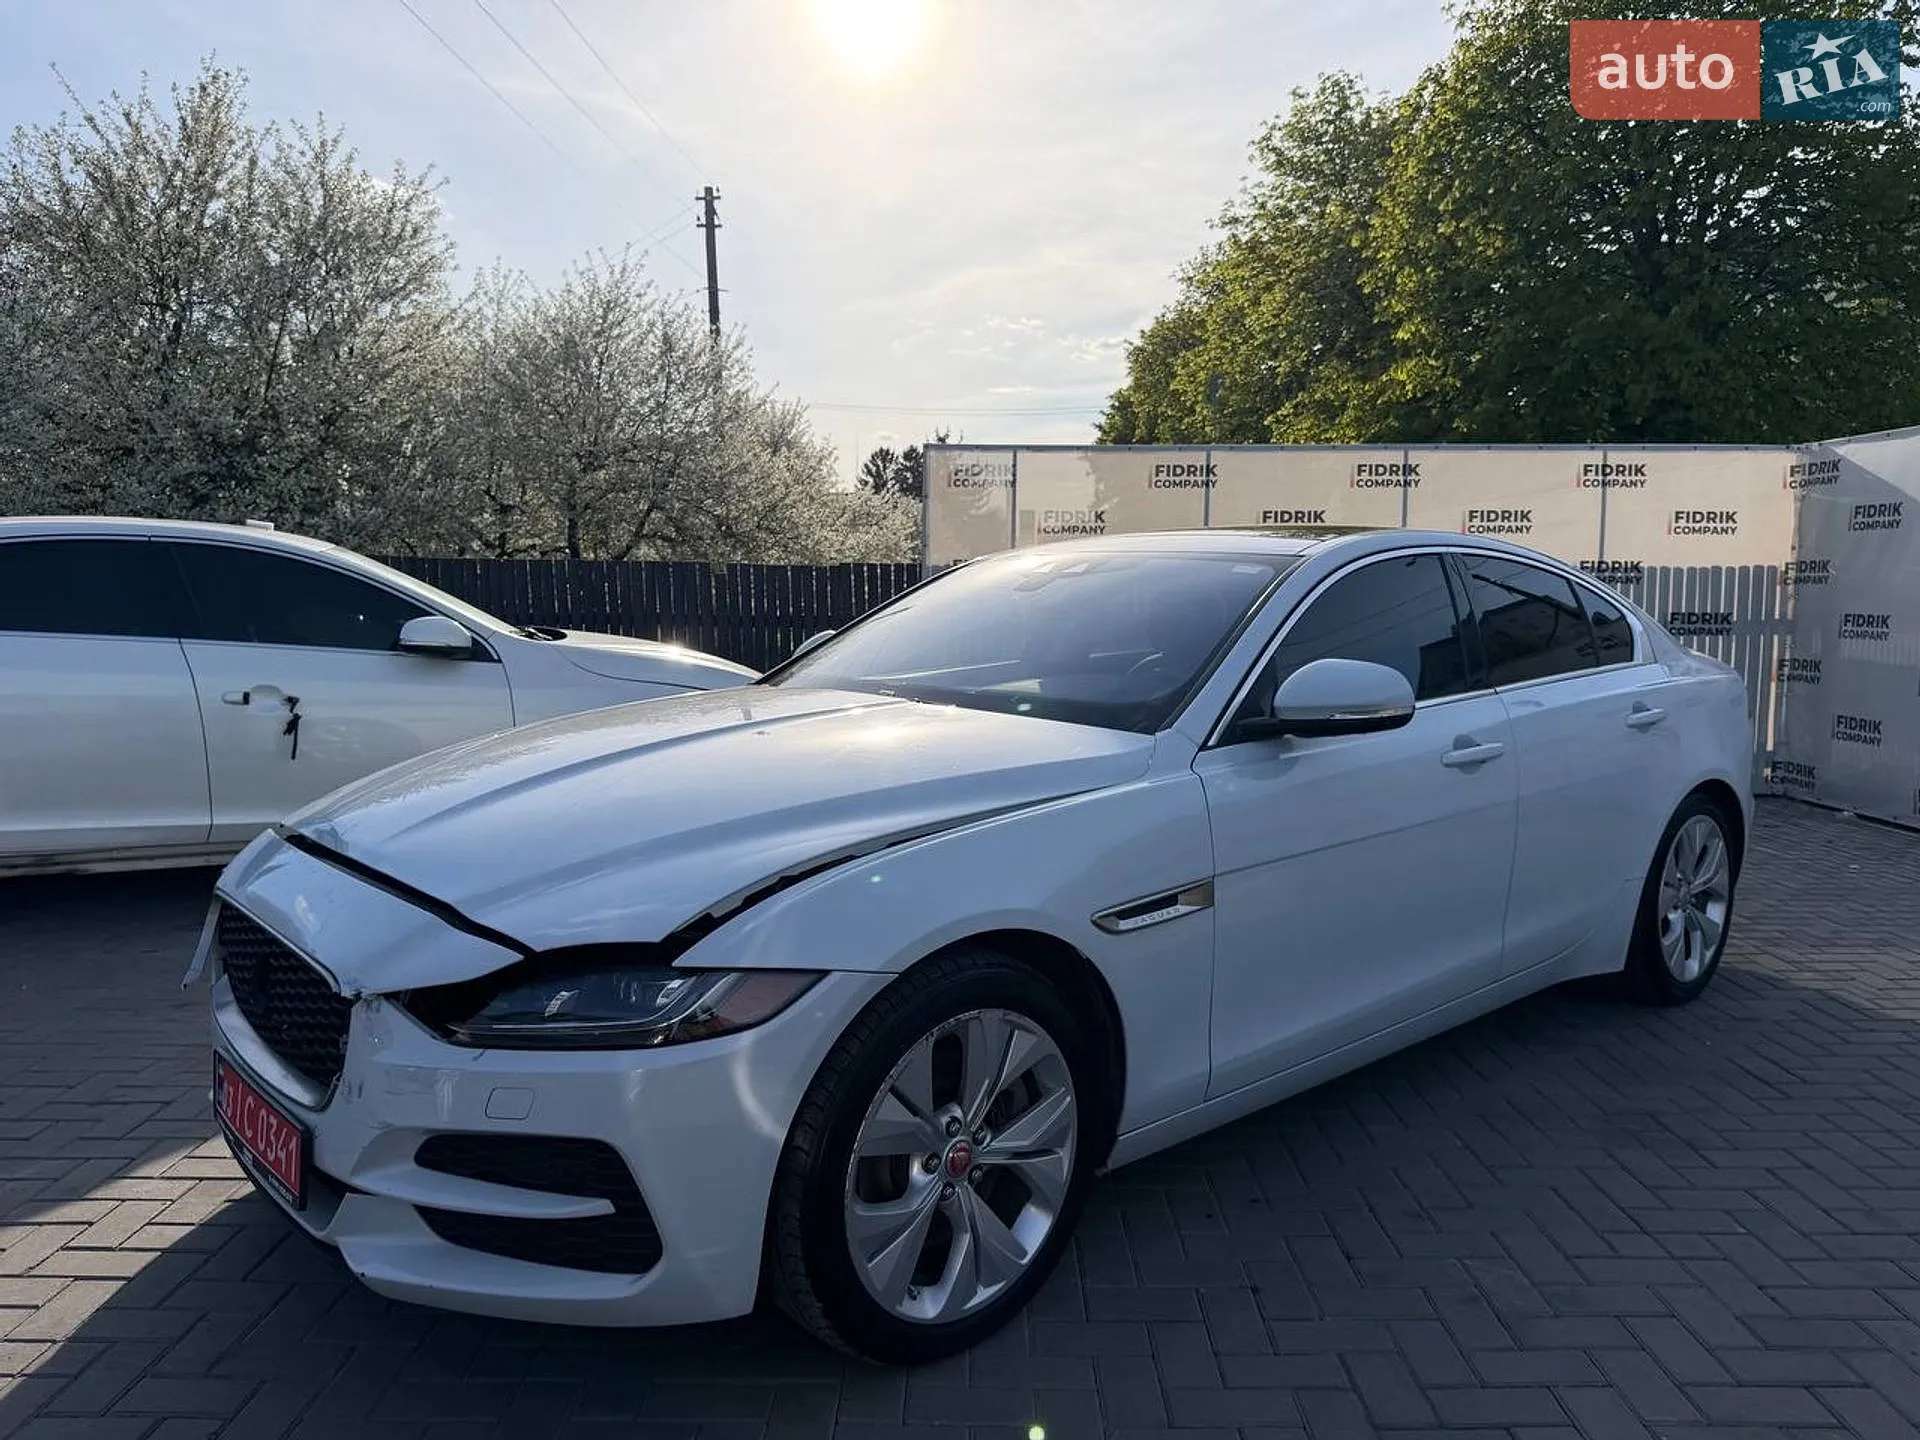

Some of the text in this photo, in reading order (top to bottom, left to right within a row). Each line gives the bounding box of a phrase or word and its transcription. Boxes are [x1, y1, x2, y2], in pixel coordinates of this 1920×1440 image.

[1154, 464, 1218, 477] FIDRIK
[1357, 464, 1421, 477] FIDRIK
[1583, 464, 1647, 477] FIDRIK
[1789, 459, 1841, 477] FIDRIK
[1154, 479, 1218, 489] COMPANY
[1356, 478, 1421, 489] COMPANY
[1583, 478, 1647, 488] COMPANY
[1789, 475, 1840, 489] COMPANY
[1043, 510, 1105, 523] FIDRIK
[1262, 510, 1326, 523] FIDRIK
[1467, 510, 1532, 523] FIDRIK
[1854, 502, 1903, 519] FIDRIK
[1674, 511, 1738, 524] FIDRIK
[1043, 525, 1106, 535] COMPANY
[1467, 525, 1532, 535] COMPANY
[1674, 526, 1738, 536] COMPANY
[1852, 519, 1902, 531] COMPANY
[1580, 560, 1643, 573] FIDRIK
[1784, 560, 1830, 575] FIDRIK
[1670, 612, 1733, 625] FIDRIK
[1843, 613, 1892, 629] FIDRIK
[1669, 627, 1732, 637] COMPANY
[1842, 629, 1891, 642] COMPANY
[1778, 658, 1821, 673] FIDRIK
[1836, 714, 1882, 736] FIDRIK
[1835, 730, 1882, 748] COMPANY
